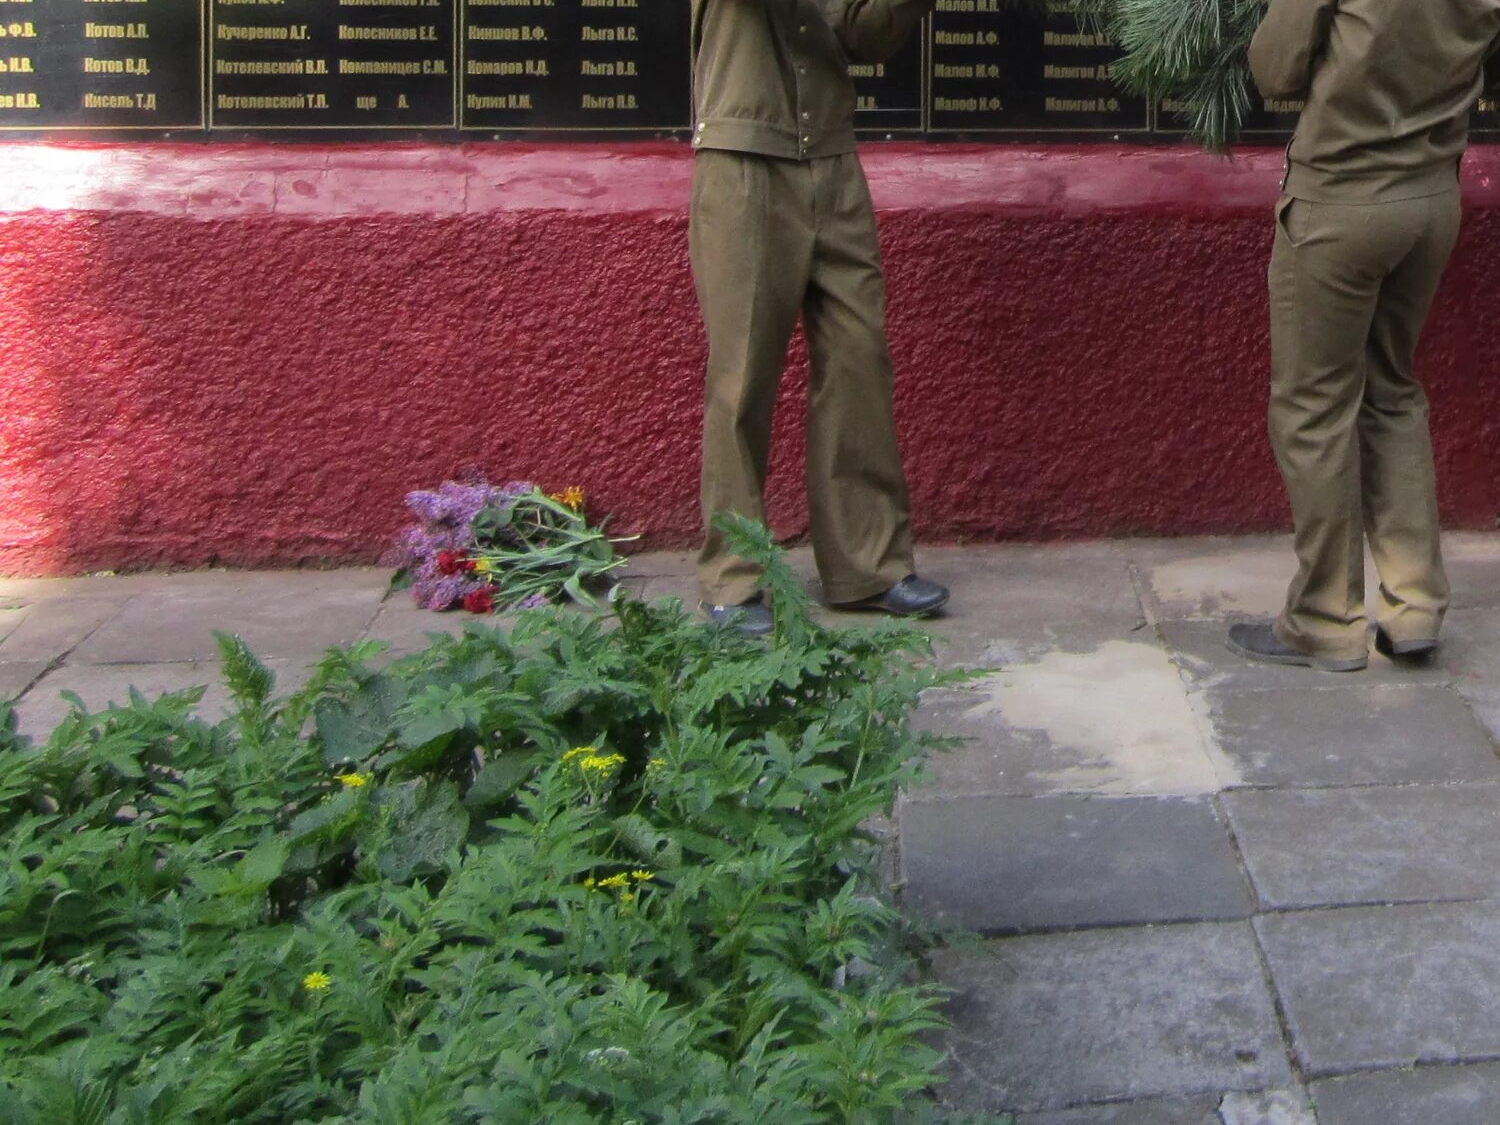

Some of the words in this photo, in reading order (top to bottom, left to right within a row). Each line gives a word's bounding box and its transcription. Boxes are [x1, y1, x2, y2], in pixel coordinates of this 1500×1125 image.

[86, 23, 124, 37] Котов
[217, 24, 287, 40] Кучеренко
[290, 25, 310, 39] А.Г.
[339, 25, 417, 40] Колесников
[582, 27, 614, 40] Лыга
[936, 31, 974, 44] Малов
[85, 58, 123, 72] Котов
[217, 59, 303, 74] Котелевский
[306, 60, 328, 74] В.П.
[468, 60, 523, 75] Комаров
[581, 61, 614, 75] Лыга
[935, 64, 973, 77] Малов
[84, 93, 133, 108] Кисель
[218, 94, 304, 108] Котелевский
[307, 94, 328, 108] Т.П.
[468, 94, 506, 109] Кулик
[582, 95, 614, 108] Лыга
